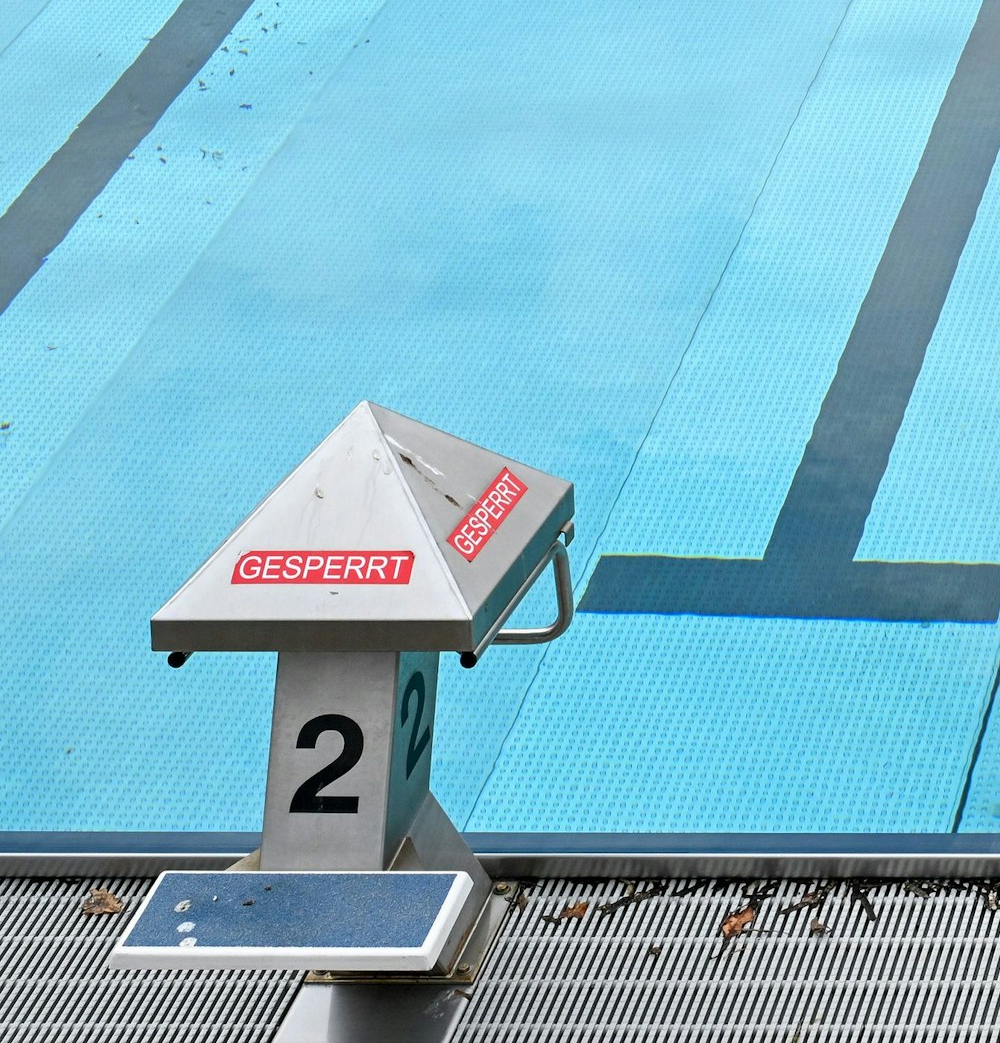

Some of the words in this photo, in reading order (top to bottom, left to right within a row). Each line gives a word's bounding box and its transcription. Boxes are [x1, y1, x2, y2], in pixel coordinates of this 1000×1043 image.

[454, 473, 521, 554] GESPERRT
[239, 556, 409, 579] GESPERRT
[289, 714, 364, 813] 2
[401, 671, 431, 780] 2
